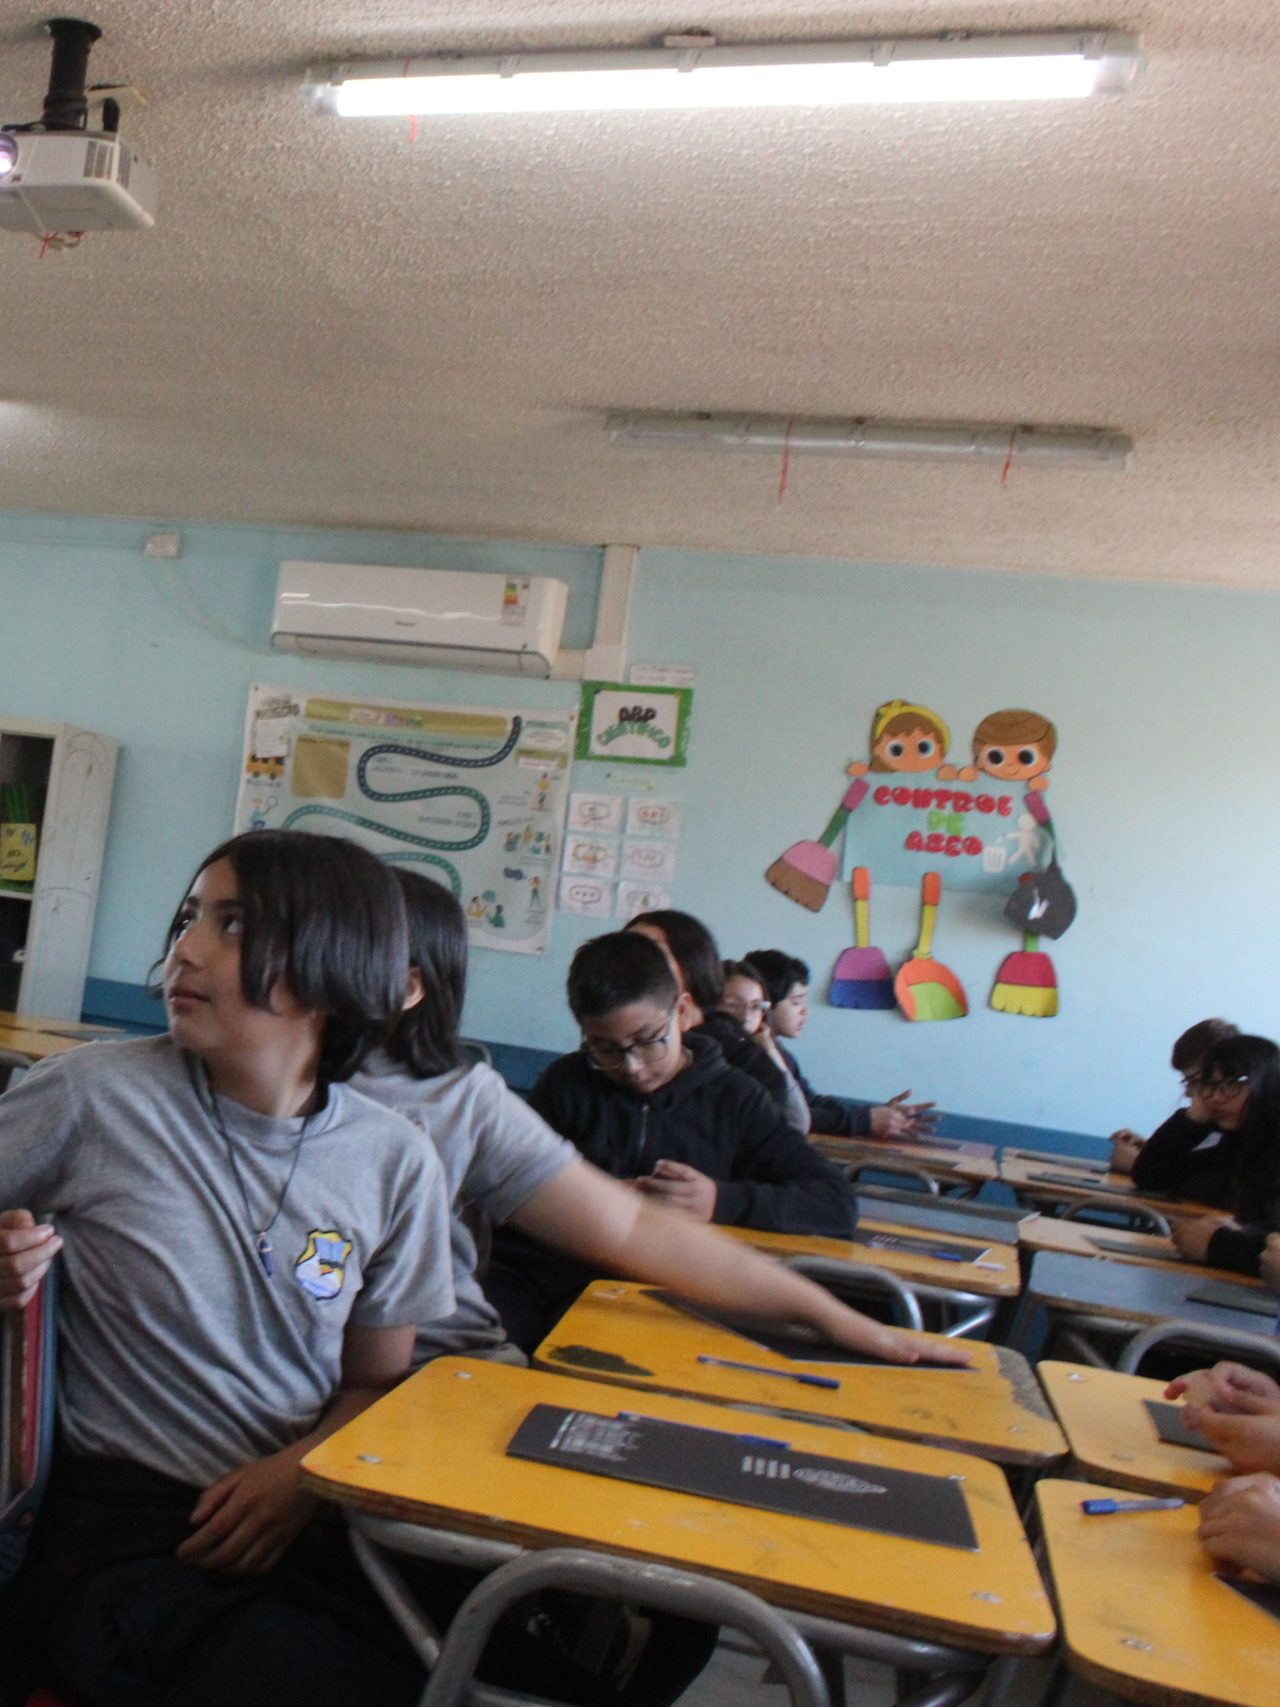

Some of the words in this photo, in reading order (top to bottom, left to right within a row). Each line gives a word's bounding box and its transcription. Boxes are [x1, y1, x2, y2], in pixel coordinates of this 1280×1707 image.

[873, 785, 1013, 817] CONTROL
[927, 810, 965, 836] DE
[904, 830, 983, 857] ASEO
